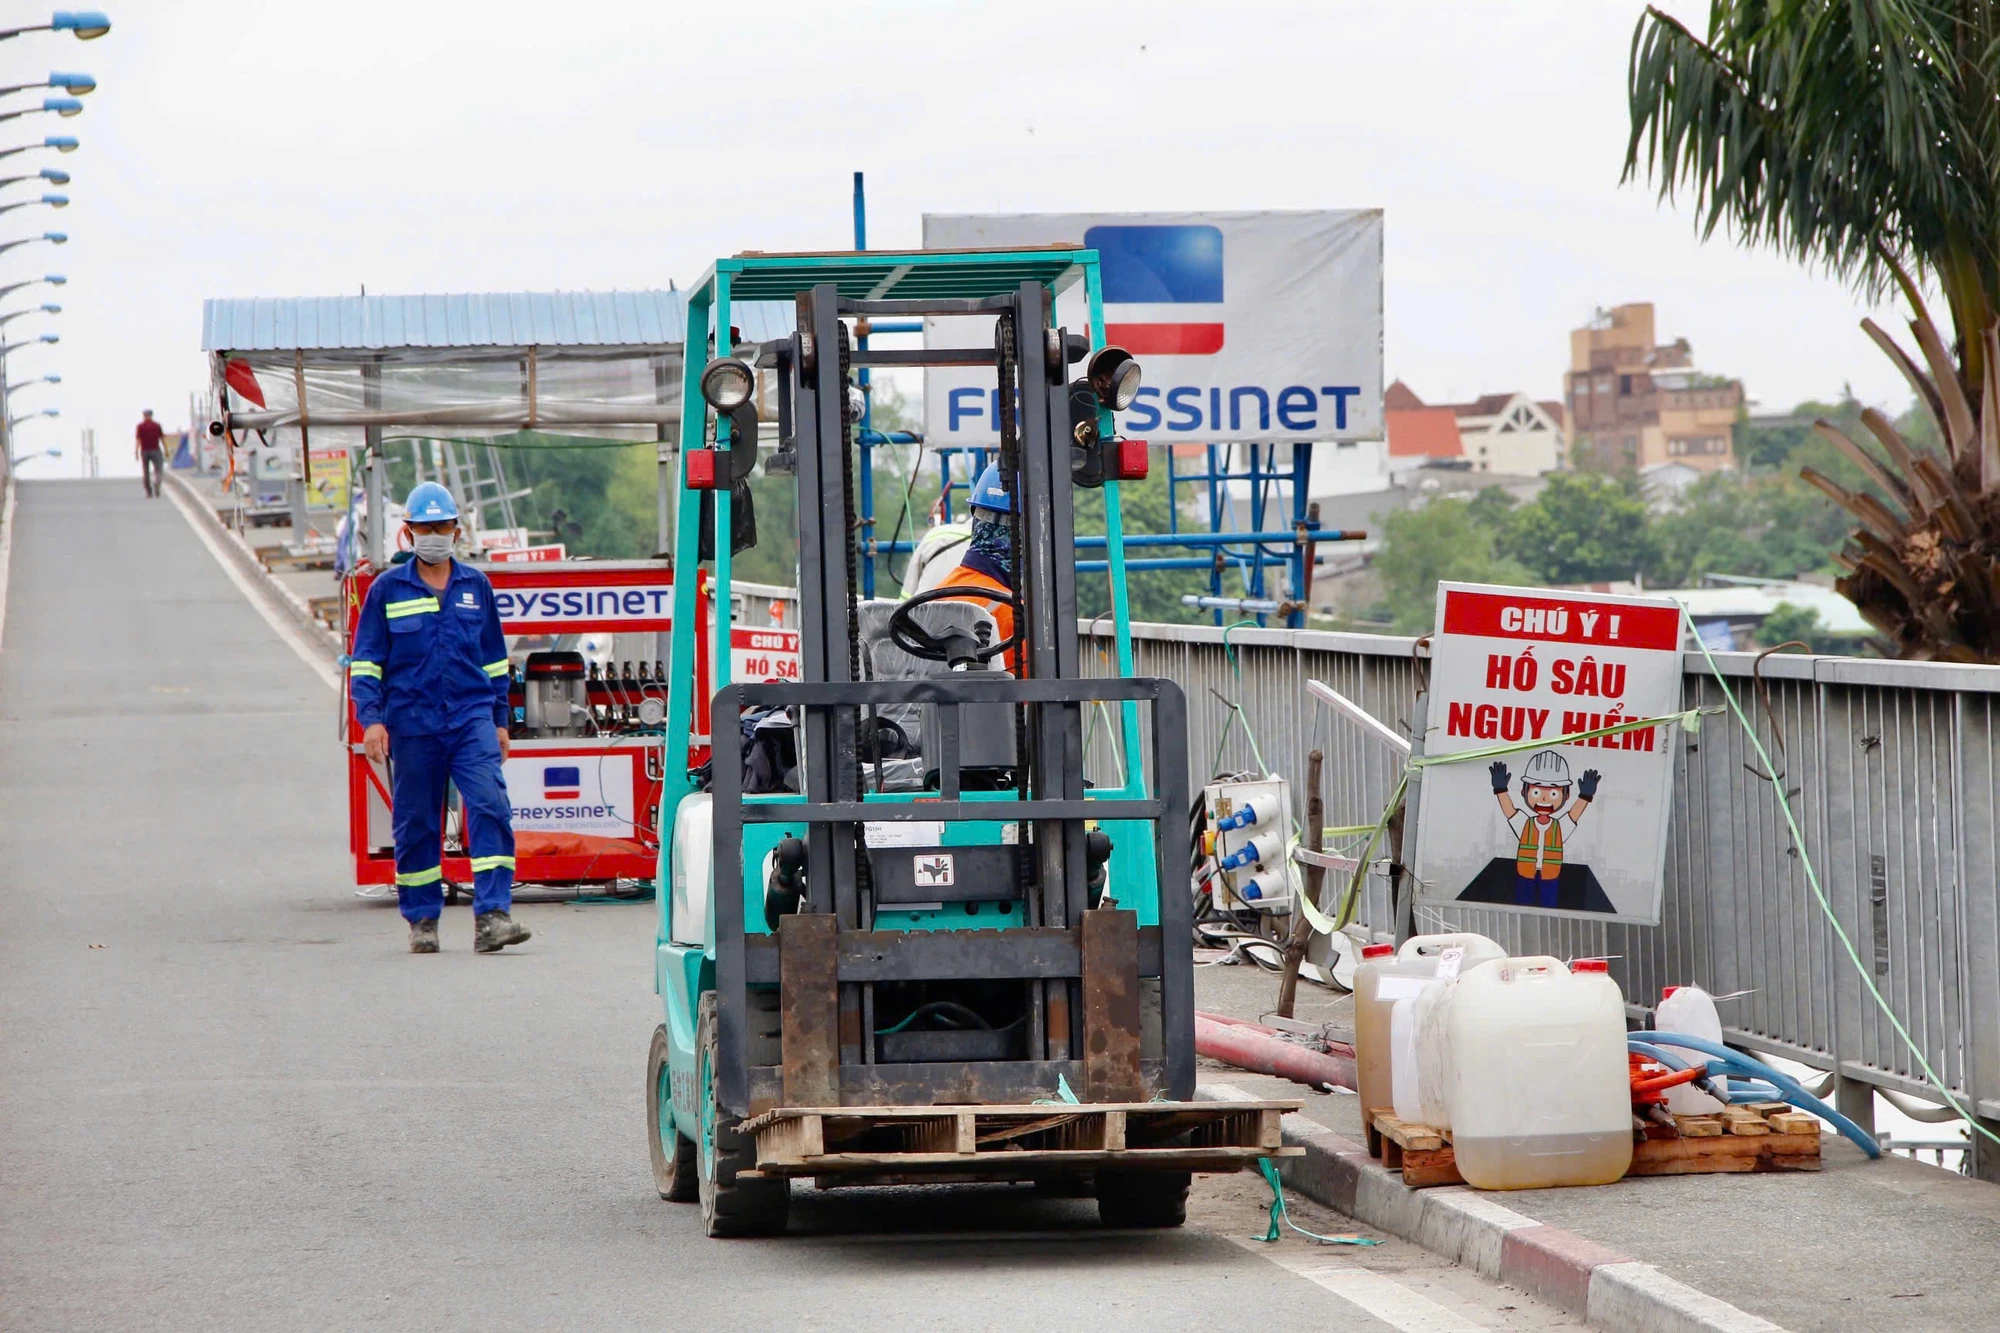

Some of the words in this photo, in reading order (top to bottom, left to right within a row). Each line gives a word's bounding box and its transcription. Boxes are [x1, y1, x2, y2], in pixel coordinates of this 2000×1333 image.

[1500, 606, 1569, 636] CHÚ
[1579, 609, 1600, 638] Ý
[1609, 615, 1621, 639] !
[751, 634, 784, 649] CHÚ
[745, 653, 769, 676] HỐ
[776, 658, 798, 677] SÂ
[1486, 646, 1538, 692] HỐ
[1551, 656, 1627, 698] SÂU
[1447, 702, 1550, 742] NGUY
[1561, 702, 1656, 752] HIỂM
